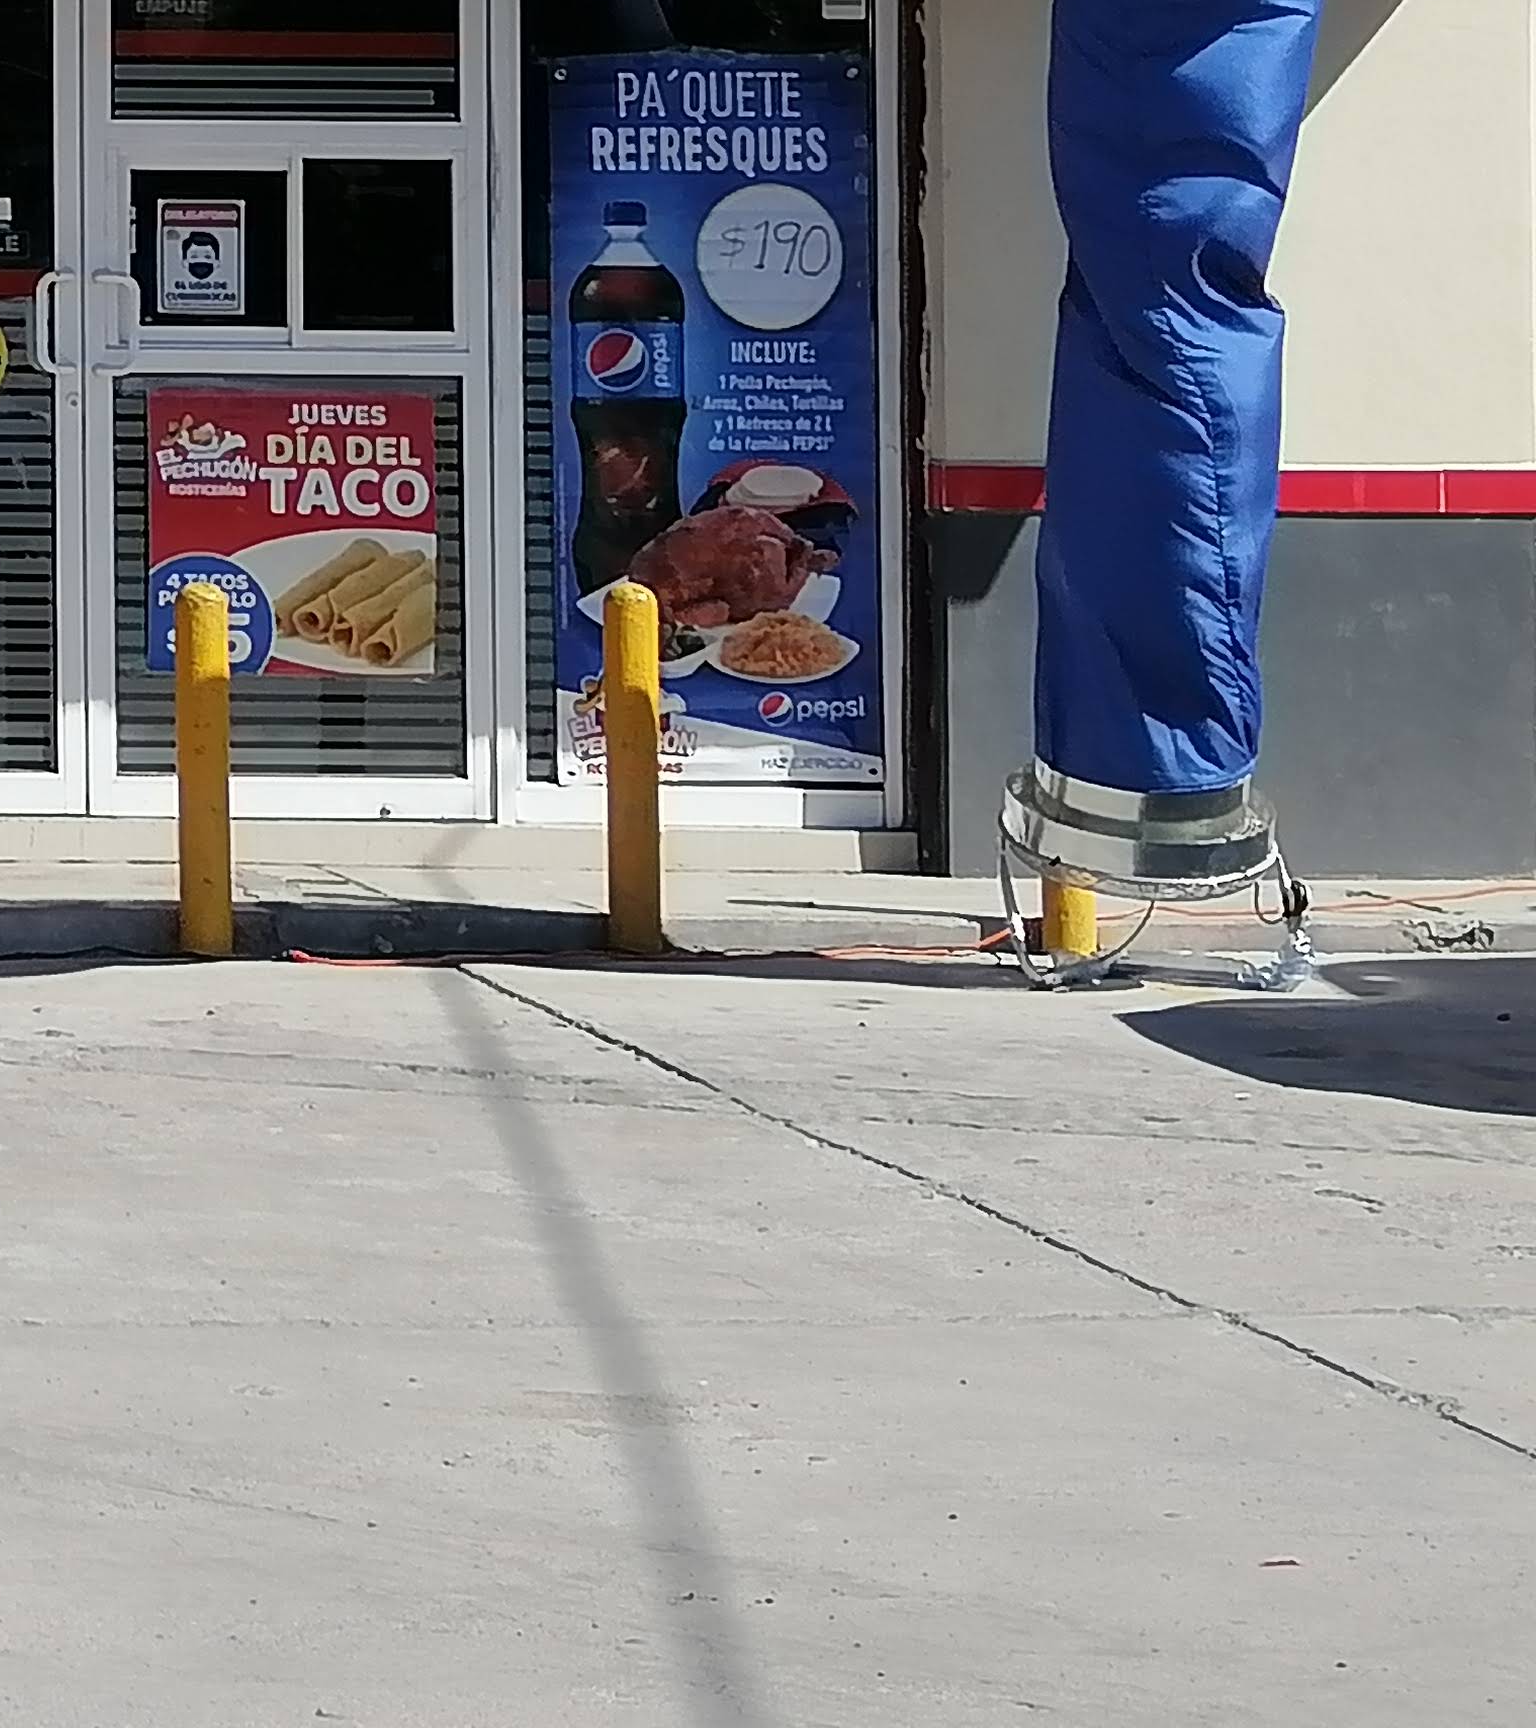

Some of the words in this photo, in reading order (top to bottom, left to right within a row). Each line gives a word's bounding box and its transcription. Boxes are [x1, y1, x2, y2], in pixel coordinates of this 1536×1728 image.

[590, 126, 830, 178] REFRESQUES
[720, 219, 833, 279] $190
[730, 340, 817, 364] INCLUYE:
[287, 402, 388, 427] JUEVES
[266, 425, 337, 466] DÍA
[345, 435, 422, 467] DEL
[258, 467, 431, 518] TACO
[165, 573, 182, 589] 4
[796, 699, 867, 723] pepsi
